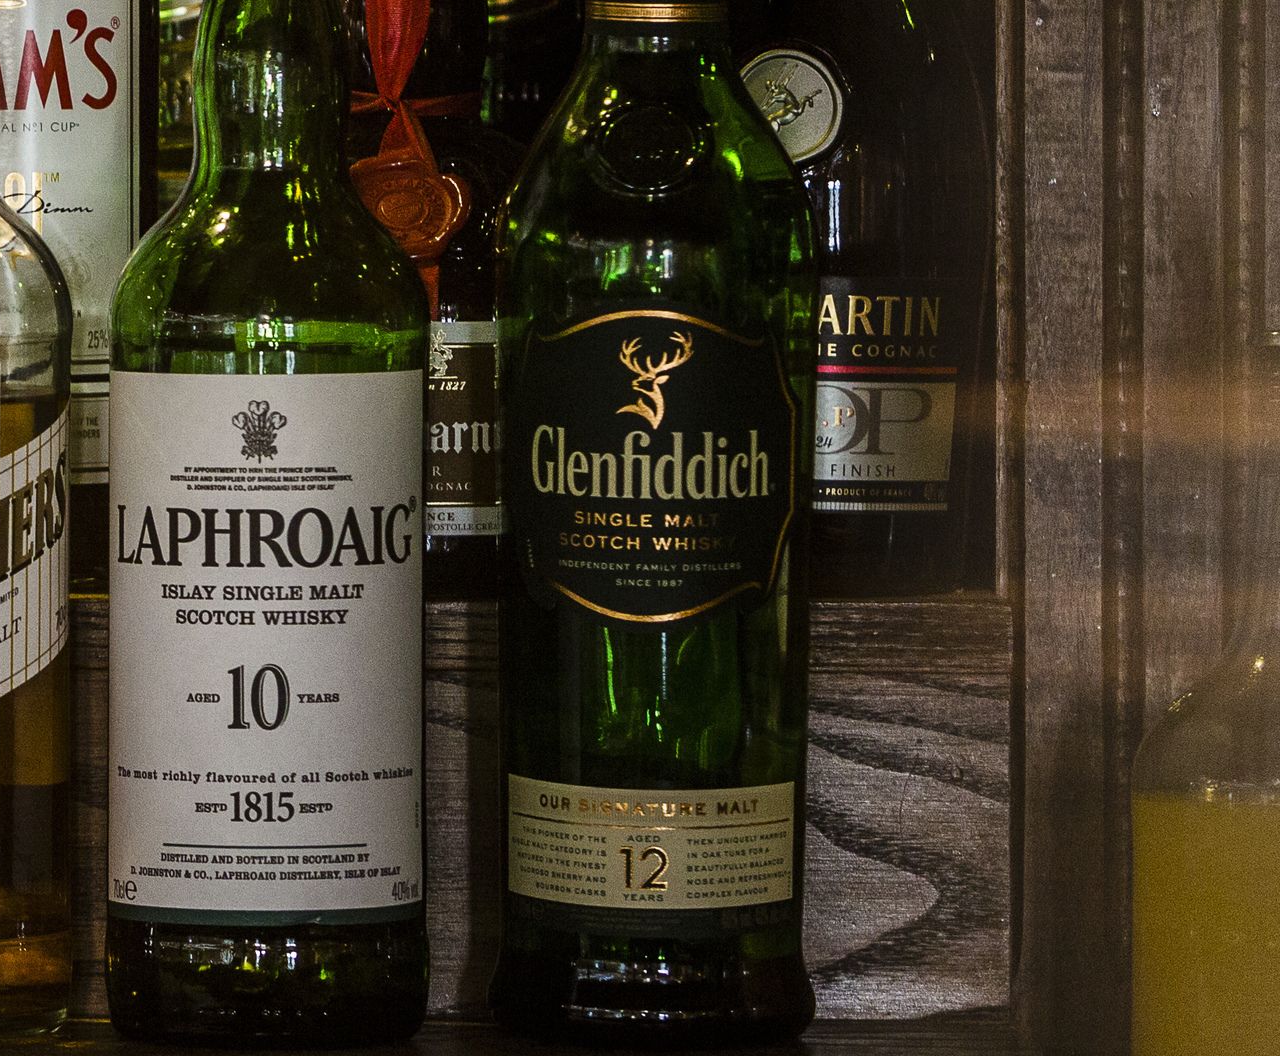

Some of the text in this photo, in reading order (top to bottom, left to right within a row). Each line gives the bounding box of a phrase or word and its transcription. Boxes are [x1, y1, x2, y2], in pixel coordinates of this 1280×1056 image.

[818, 294, 939, 337] ARTIN
[852, 344, 937, 357] COGNAC
[532, 425, 769, 500] Glenfiddich
[831, 464, 895, 477] FINISH
[574, 511, 652, 528] SINGLE
[118, 503, 412, 568] LAPHROAIG
[559, 532, 640, 550] SCOTCH
[162, 584, 364, 601] ISLAY SINGLE MALT
[175, 609, 349, 626] SCOTCH WHISKY
[186, 663, 340, 731] AGED 10 YEARS
[117, 766, 413, 784] The most richly flavoured of all Scotch whiskies
[195, 791, 333, 823] ESTD 1815 ESTD
[540, 795, 758, 817] OUR SIGNATURE MALT
[627, 835, 660, 843] AGED
[161, 853, 370, 864] DISTILLED AND BOTTLED IN SCOTLAND BY
[619, 846, 670, 891] 12
[623, 893, 664, 902] YEARS
